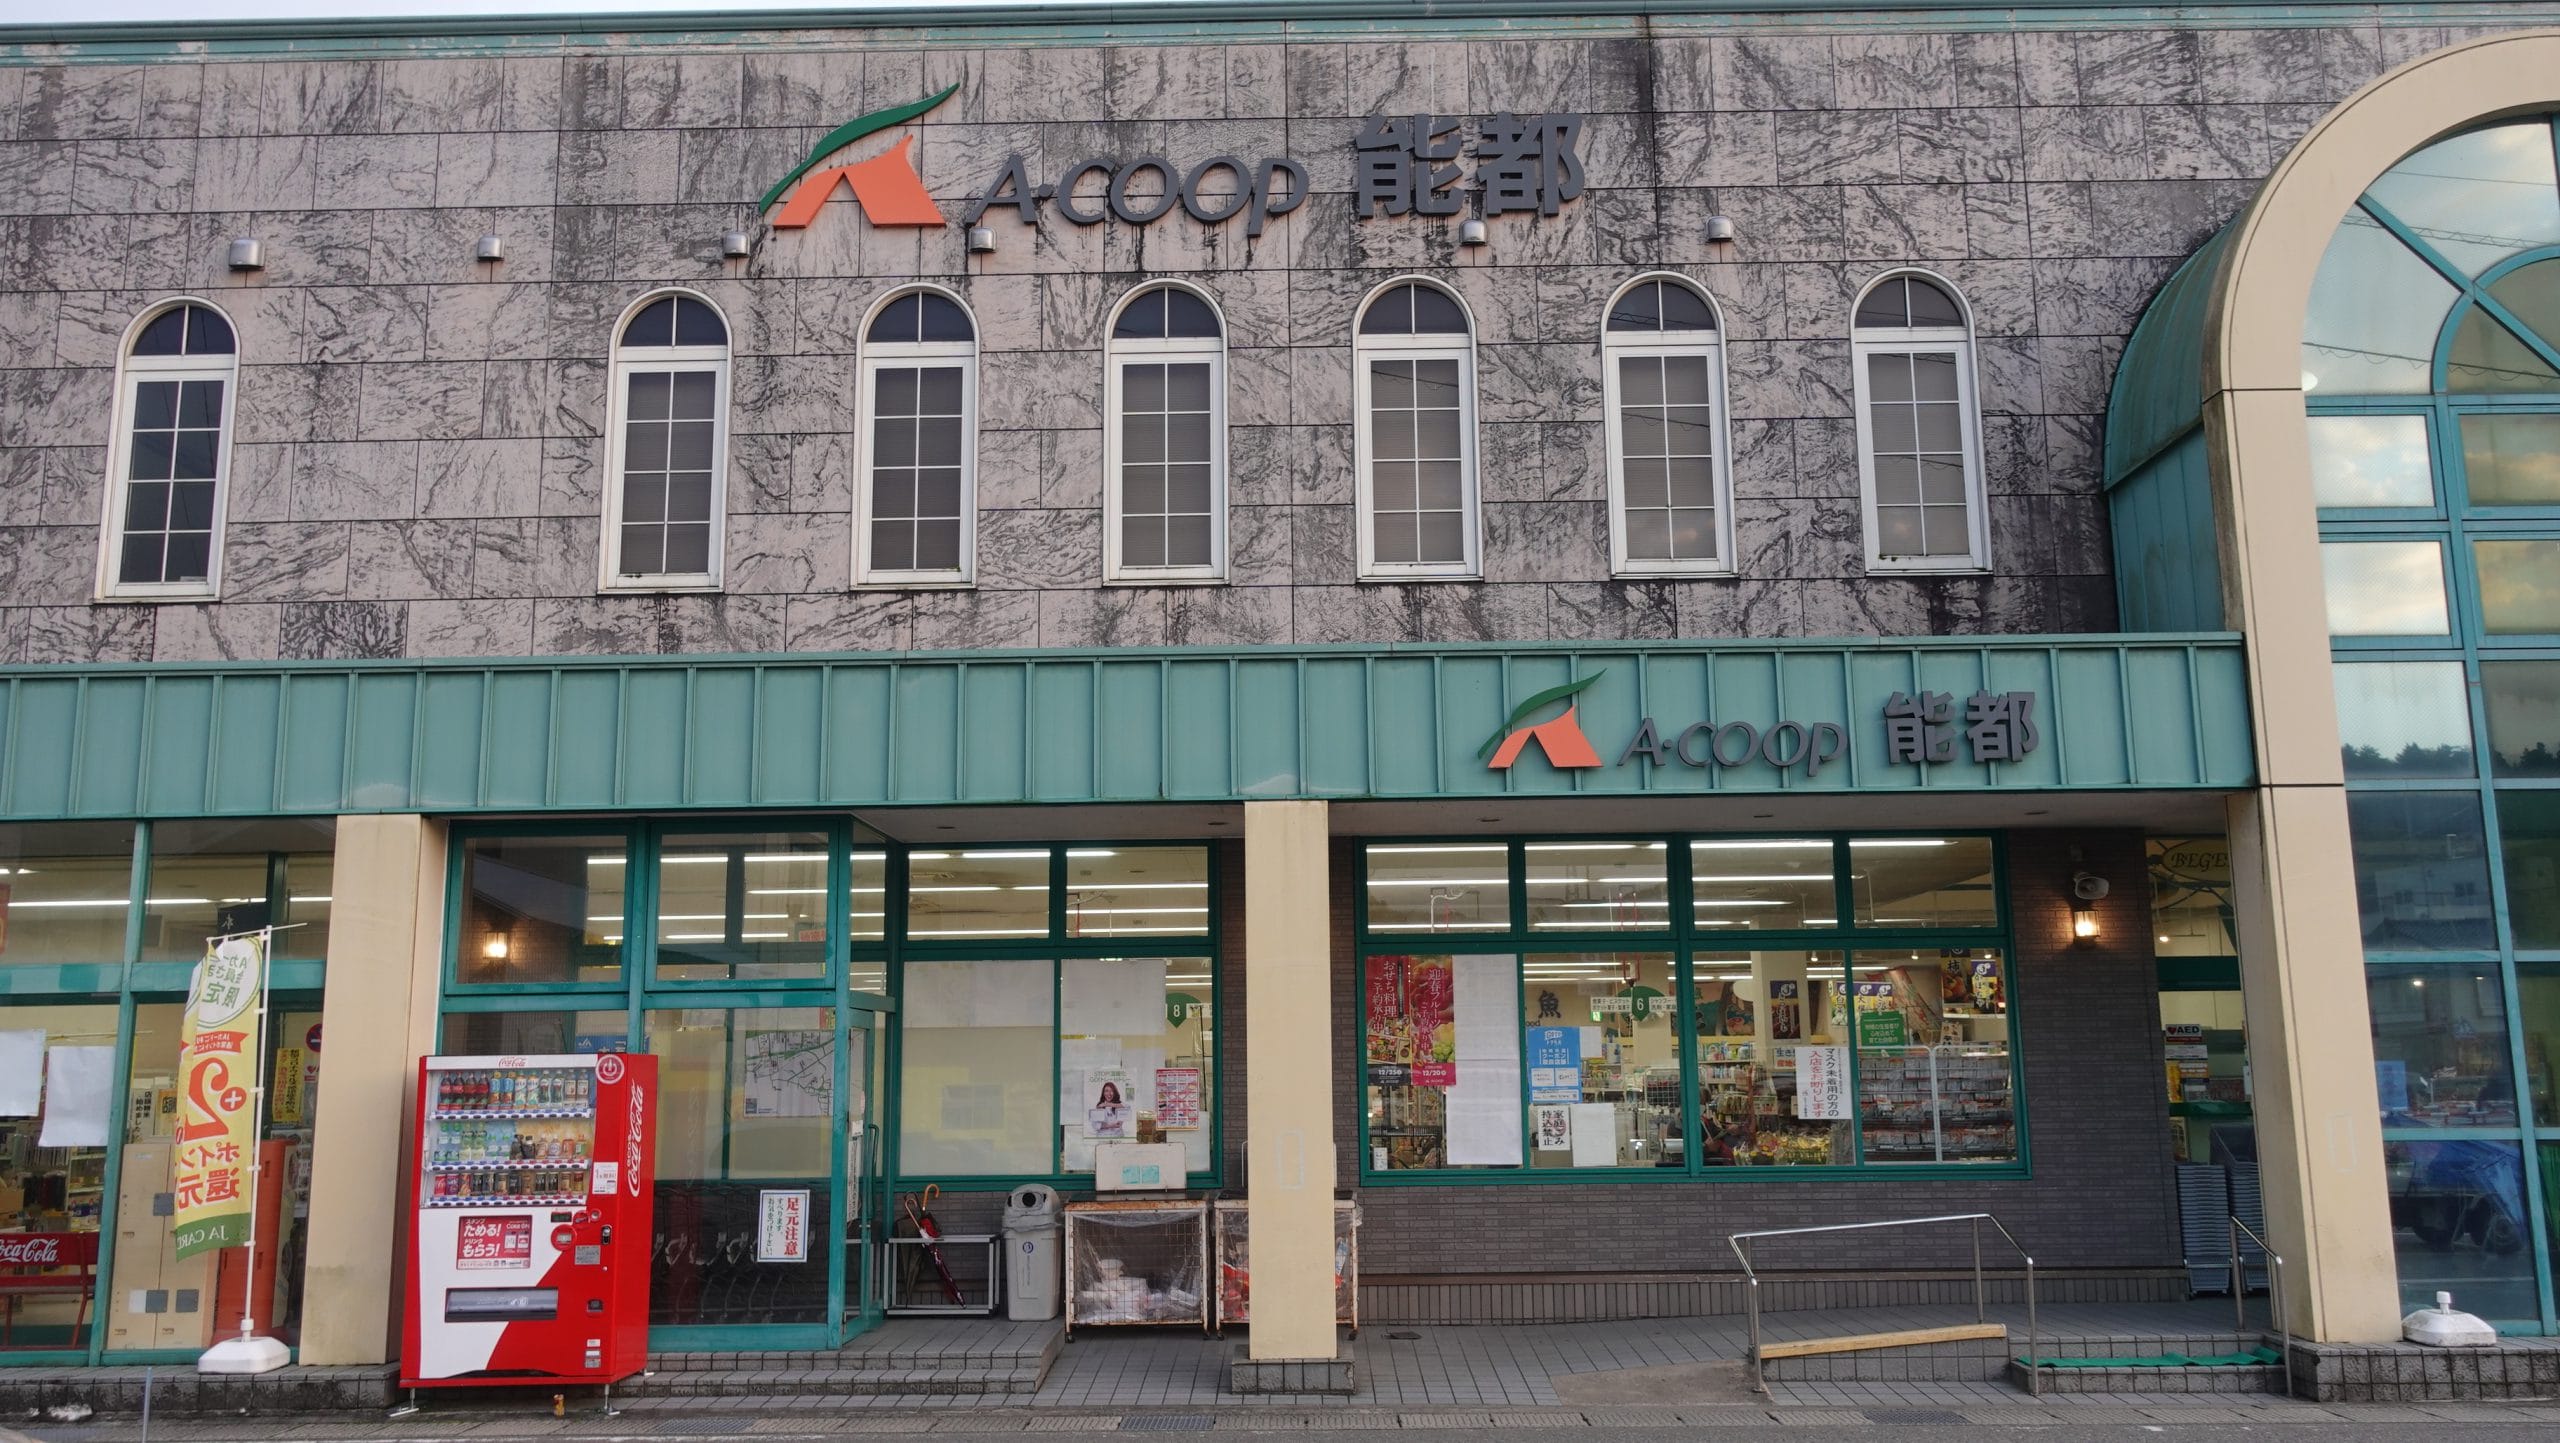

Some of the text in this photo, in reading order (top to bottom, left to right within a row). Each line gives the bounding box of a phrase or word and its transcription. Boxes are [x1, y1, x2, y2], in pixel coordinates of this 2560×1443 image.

[1356, 112, 1585, 218] 能都
[1883, 690, 2040, 764] 能都
[1384, 961, 1397, 1018] おせち料理
[1428, 969, 1441, 1032] 迎春フルーツ
[1538, 989, 1562, 1019] 魚
[1636, 998, 1644, 1011] 6
[1173, 1004, 1180, 1018] 8
[2177, 1026, 2200, 1034] AED
[1809, 1050, 1825, 1119] 入店をお断りします
[1826, 1048, 1840, 1118] マスク未着用の方の
[627, 1079, 643, 1198] Coca-Cola
[1542, 1109, 1554, 1146] 持込禁止
[1553, 1109, 1566, 1146] 家庭ごみ
[463, 1223, 502, 1237] ためる!
[784, 1197, 799, 1256] 足元注意
[0, 1238, 60, 1263] oca-Cola
[462, 1243, 501, 1258] もらう!
